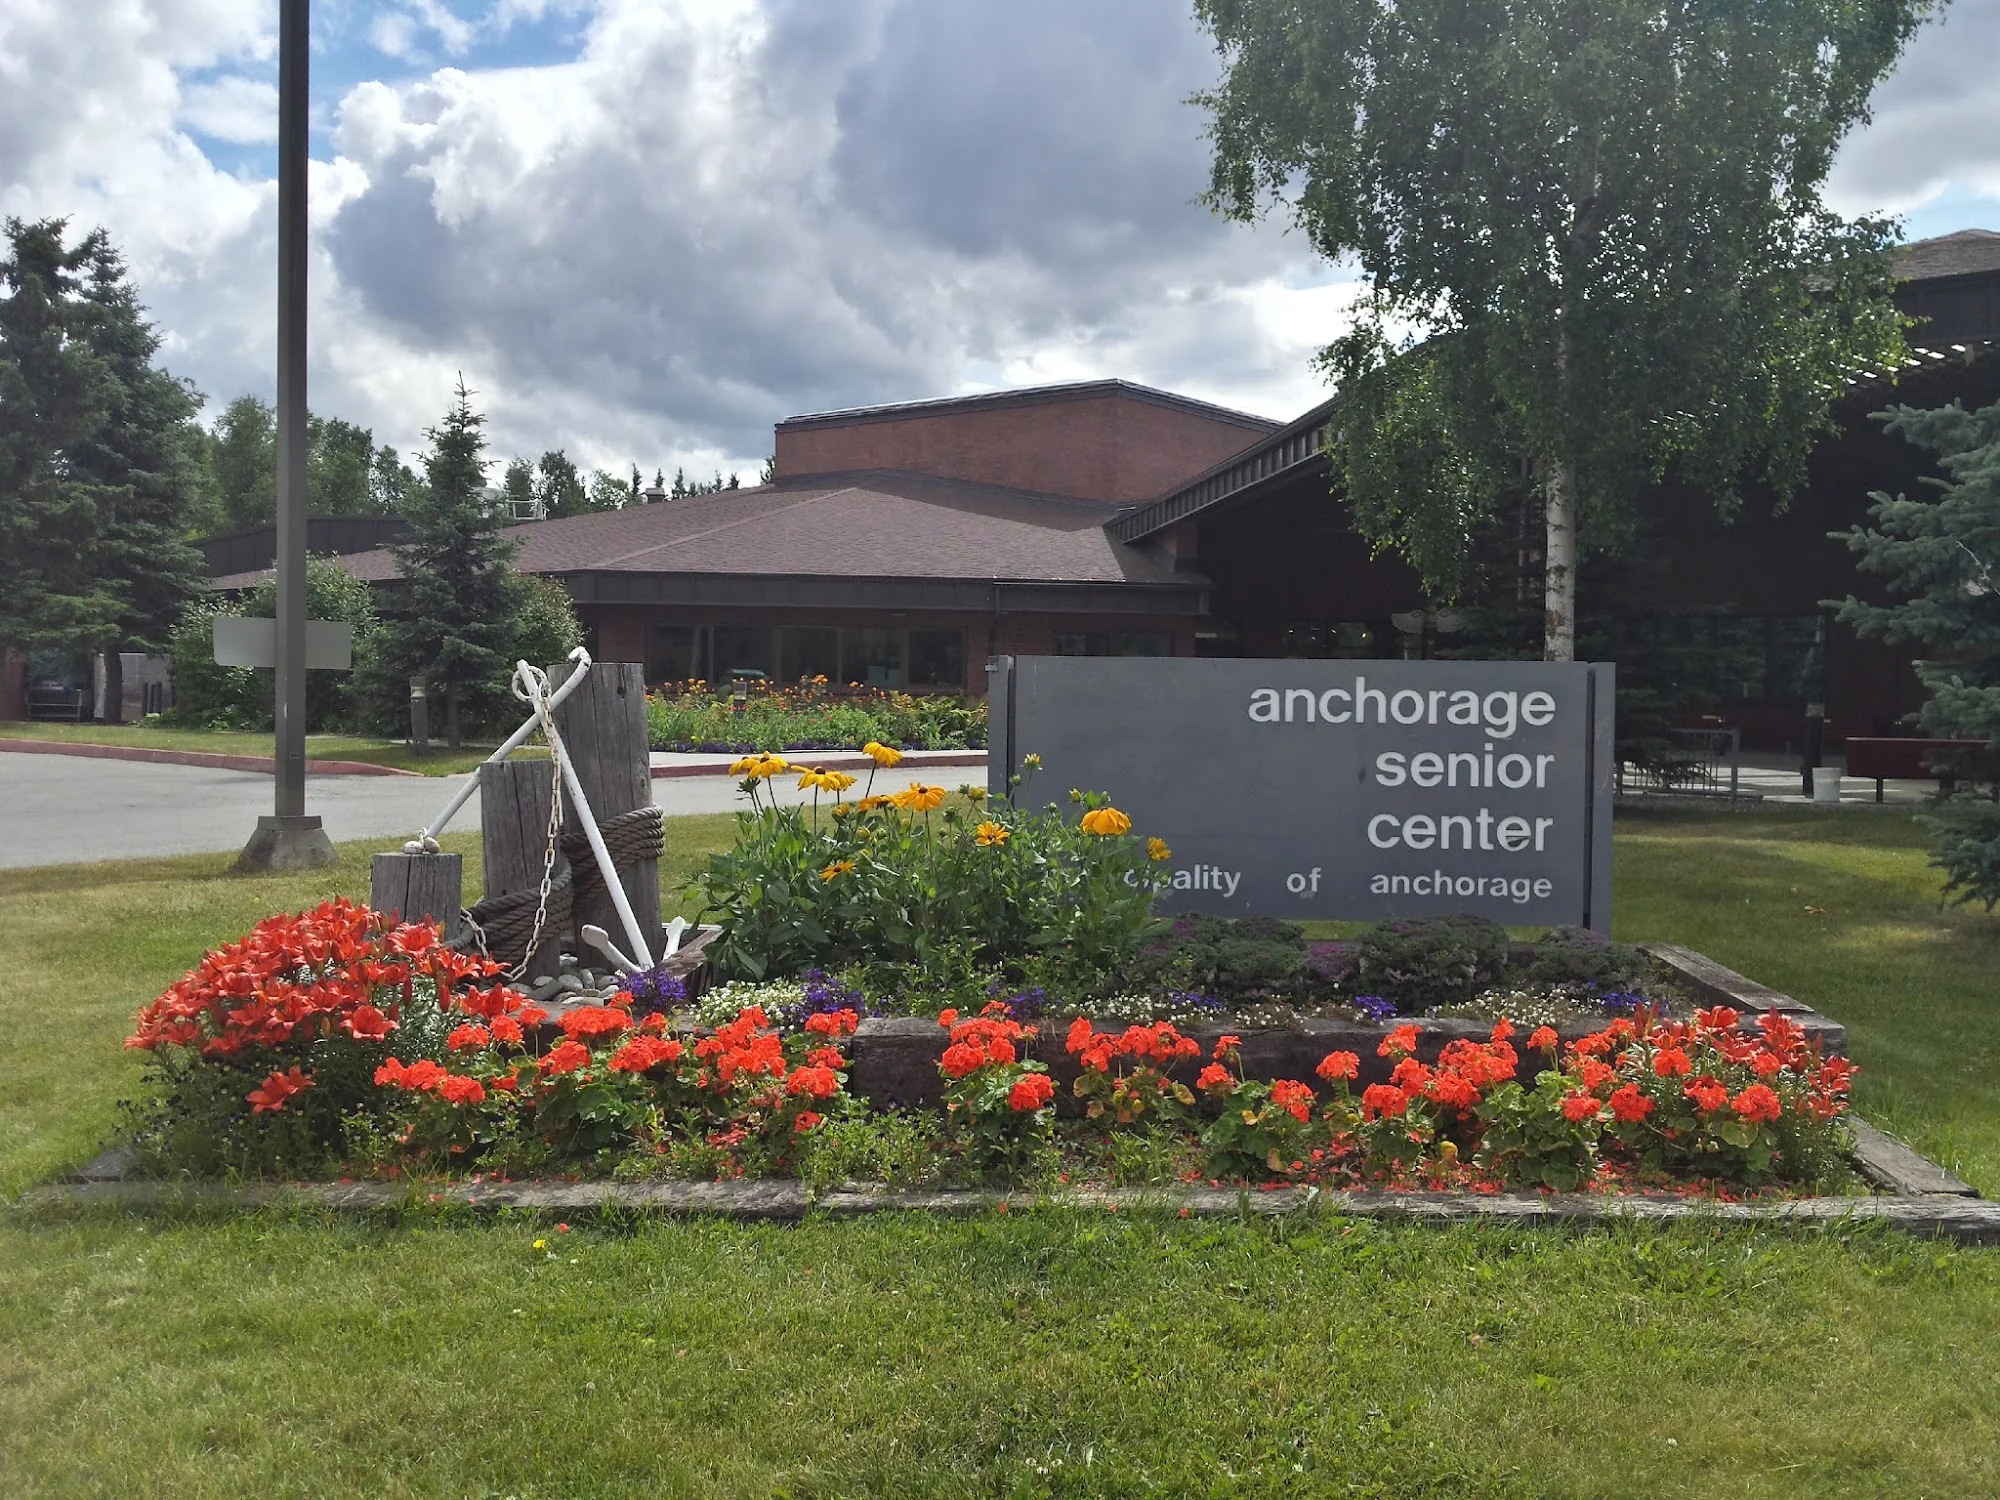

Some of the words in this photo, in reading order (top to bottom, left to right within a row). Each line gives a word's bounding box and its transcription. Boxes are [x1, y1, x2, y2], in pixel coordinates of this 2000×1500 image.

[1248, 676, 1557, 739] anchorage
[1375, 742, 1555, 789] senior
[1367, 807, 1554, 852] center
[1286, 867, 1322, 894] of
[1370, 868, 1553, 904] anchorage
